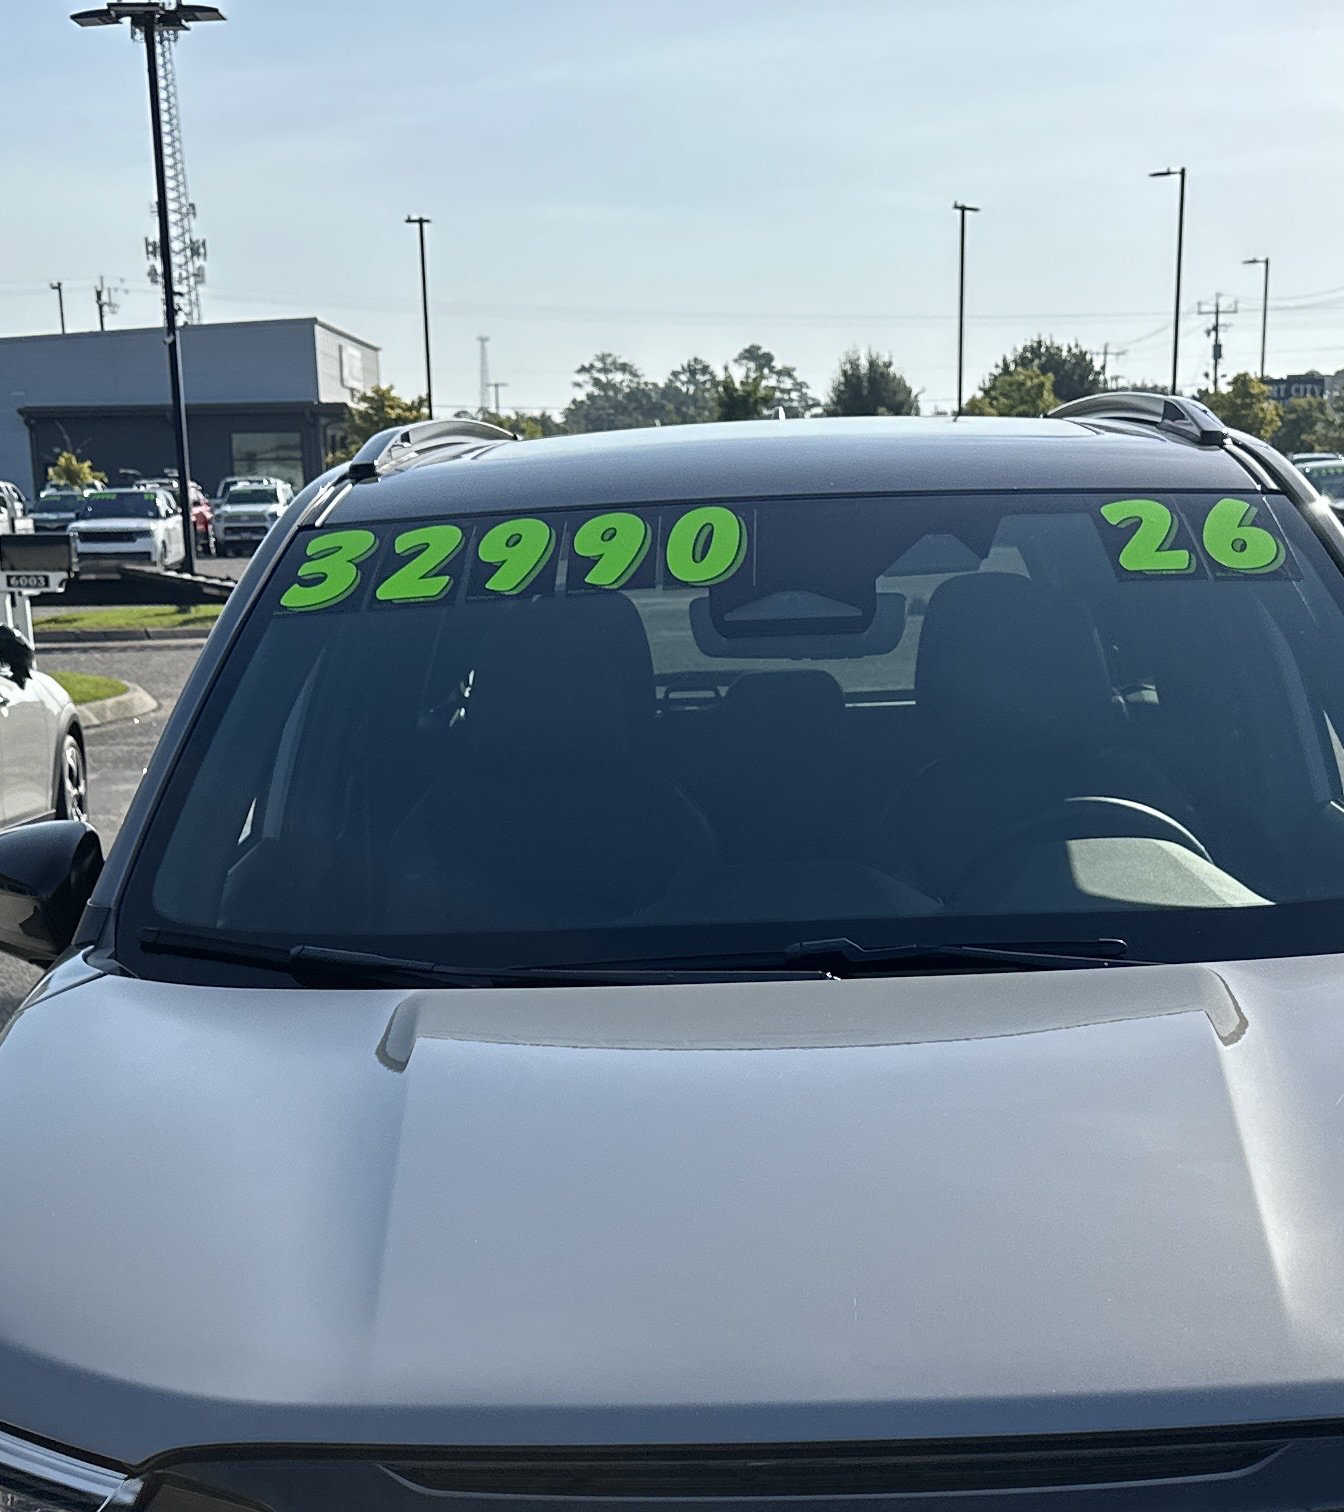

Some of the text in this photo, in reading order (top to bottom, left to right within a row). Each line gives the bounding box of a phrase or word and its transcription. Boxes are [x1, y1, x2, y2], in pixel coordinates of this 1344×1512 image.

[9, 575, 47, 588] 6003
[280, 500, 1286, 612] 32990 26
